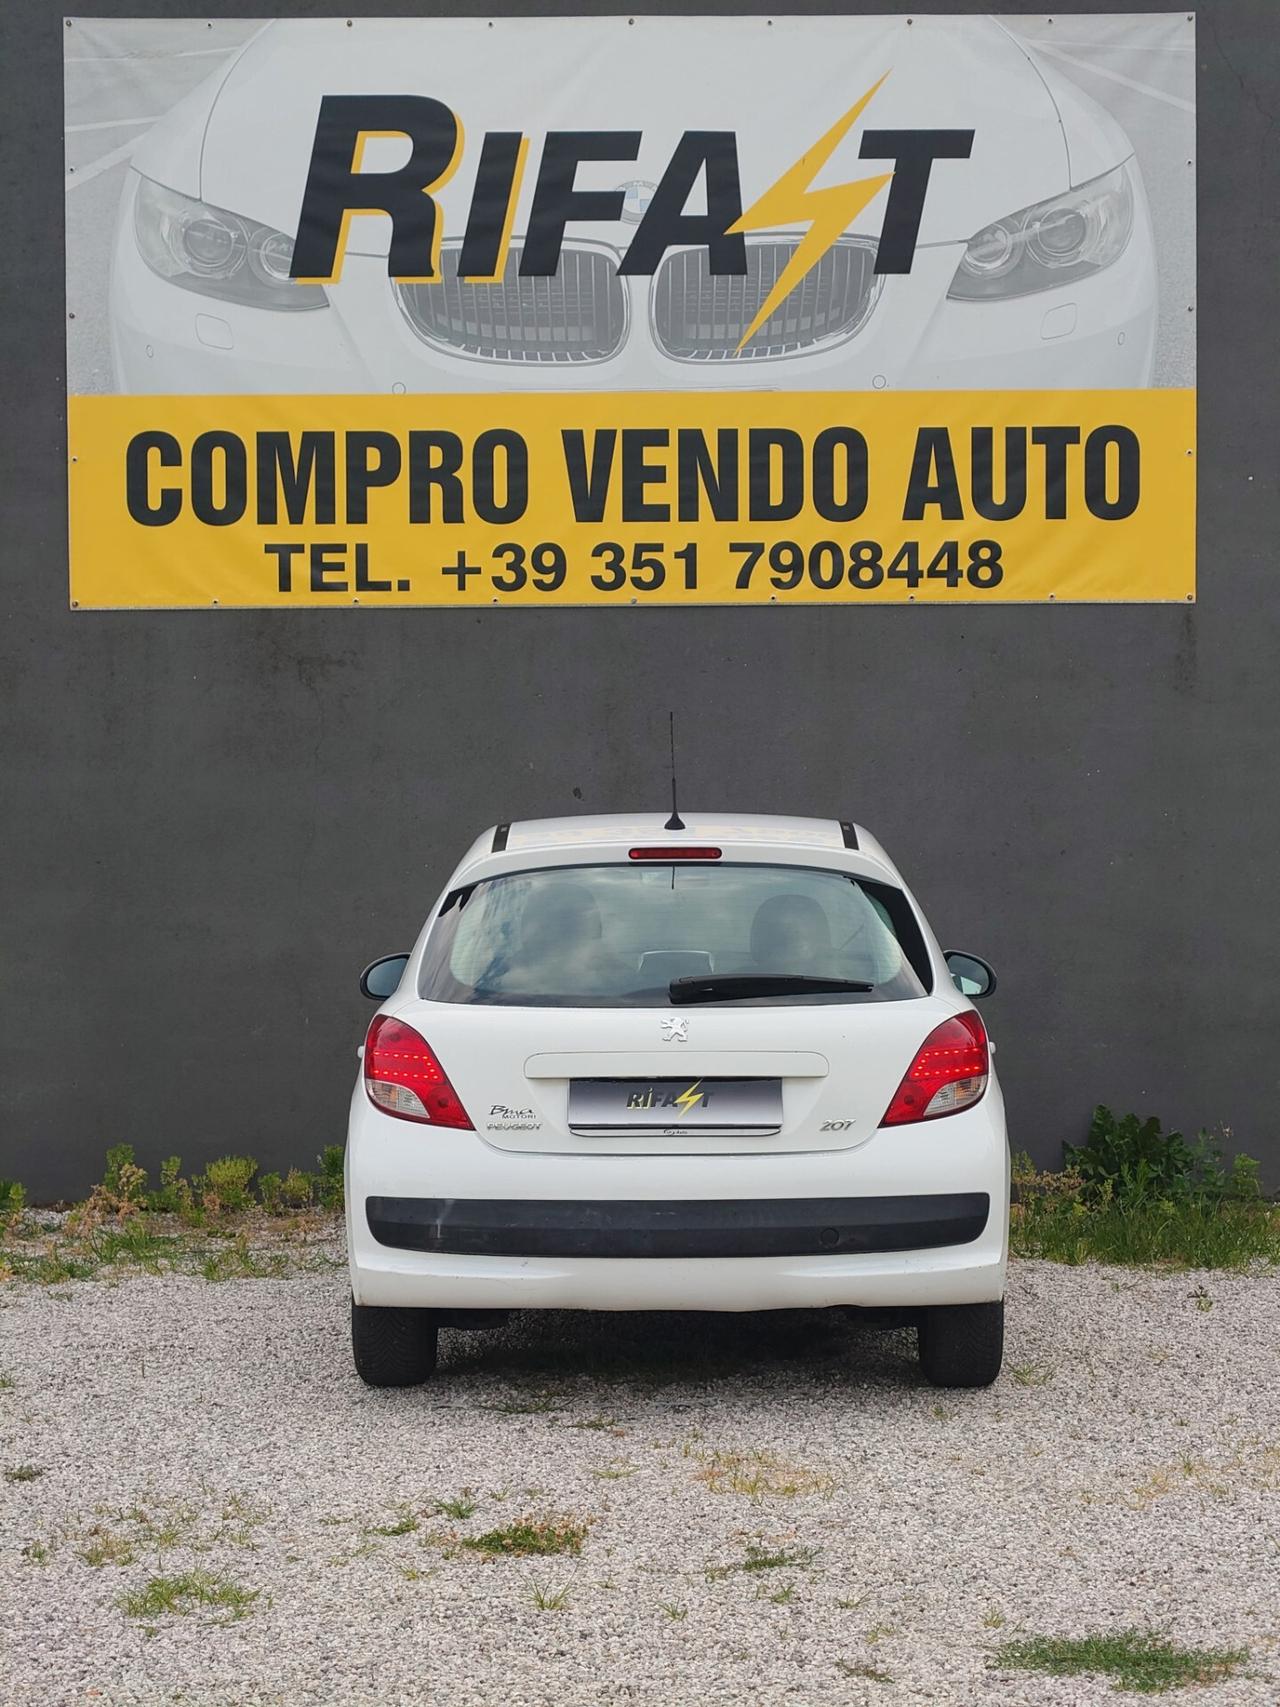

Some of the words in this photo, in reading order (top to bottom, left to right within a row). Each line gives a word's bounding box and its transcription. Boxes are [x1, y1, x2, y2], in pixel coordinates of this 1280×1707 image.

[127, 429, 528, 526] COMPRO
[561, 427, 868, 522] VENDO
[903, 425, 1140, 521] AUTO
[265, 544, 409, 592] TEL.
[442, 543, 566, 591] +39
[591, 542, 697, 591] 351
[730, 540, 1003, 589] 7908448
[486, 1122, 543, 1131] PEUGEOT
[819, 1119, 856, 1131] 207
